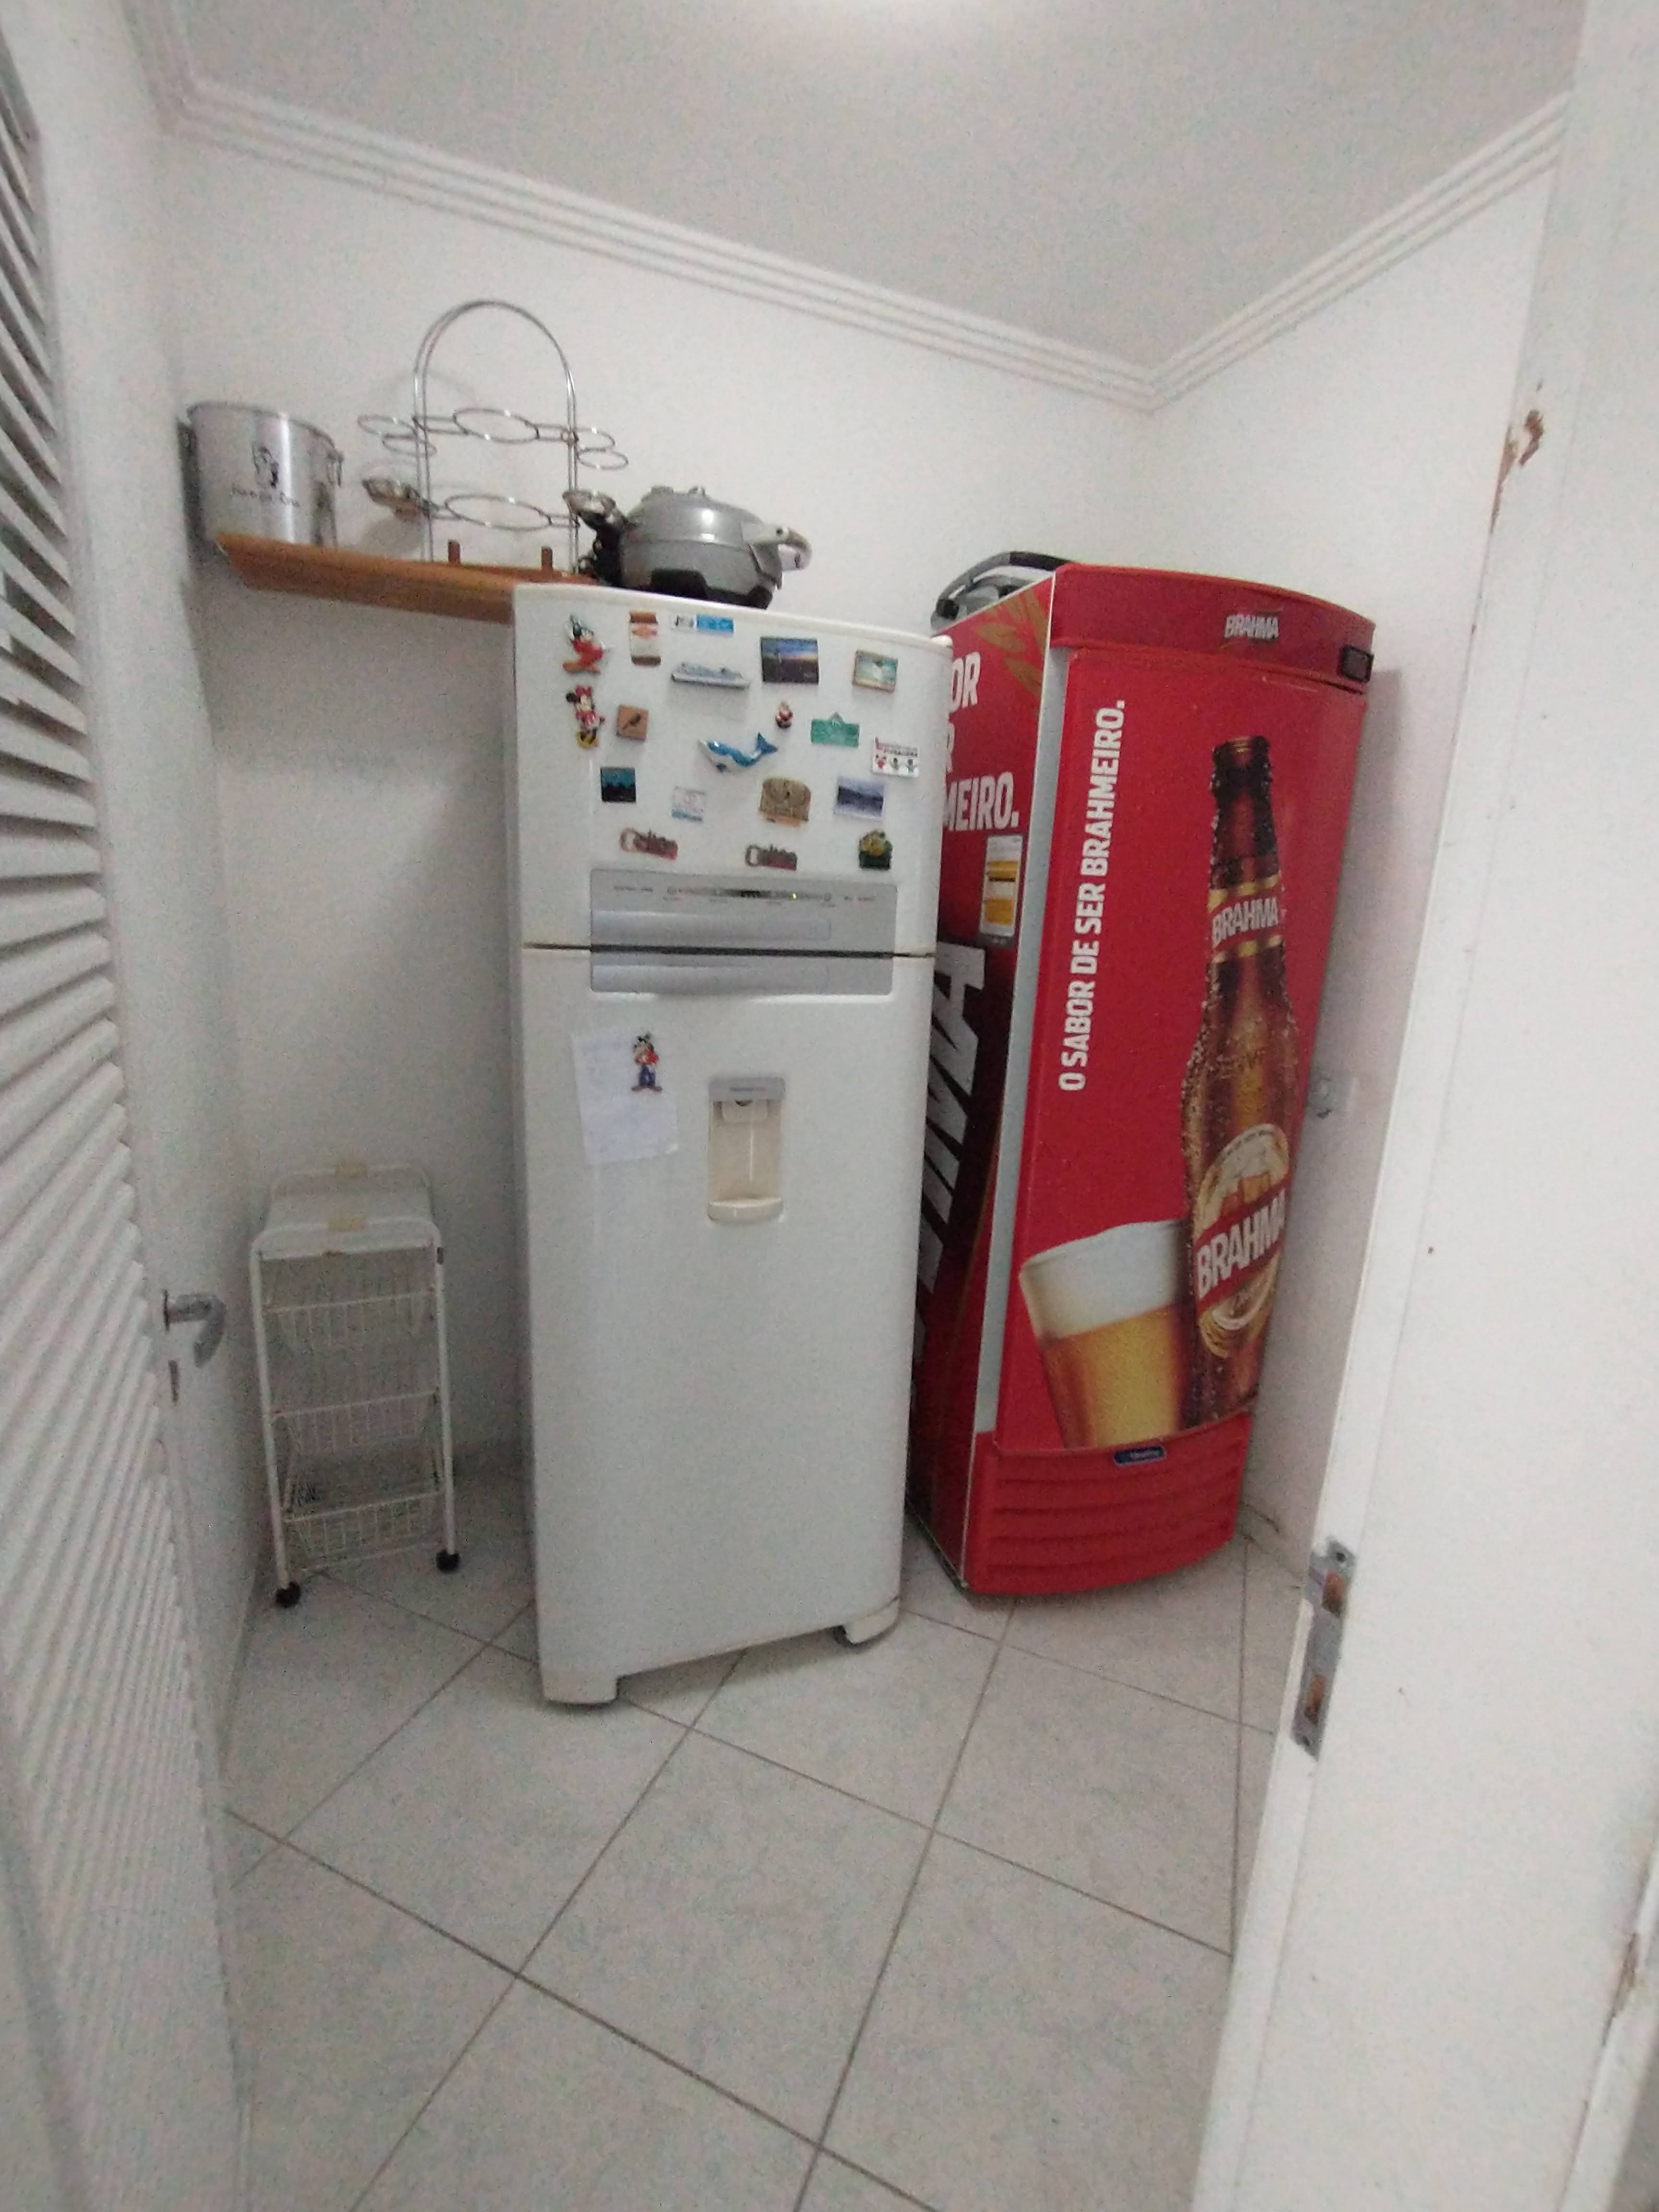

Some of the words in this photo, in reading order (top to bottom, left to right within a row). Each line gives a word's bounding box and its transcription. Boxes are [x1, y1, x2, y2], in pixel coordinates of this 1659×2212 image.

[1224, 613, 1279, 640] BRAHMA
[1081, 700, 1125, 876] BRAHMEIRO.
[1074, 882, 1106, 935] SER
[1212, 897, 1279, 949] BRAHMA
[1070, 939, 1100, 974] DE
[1061, 980, 1096, 1068] SABOR
[1058, 1071, 1086, 1091] O
